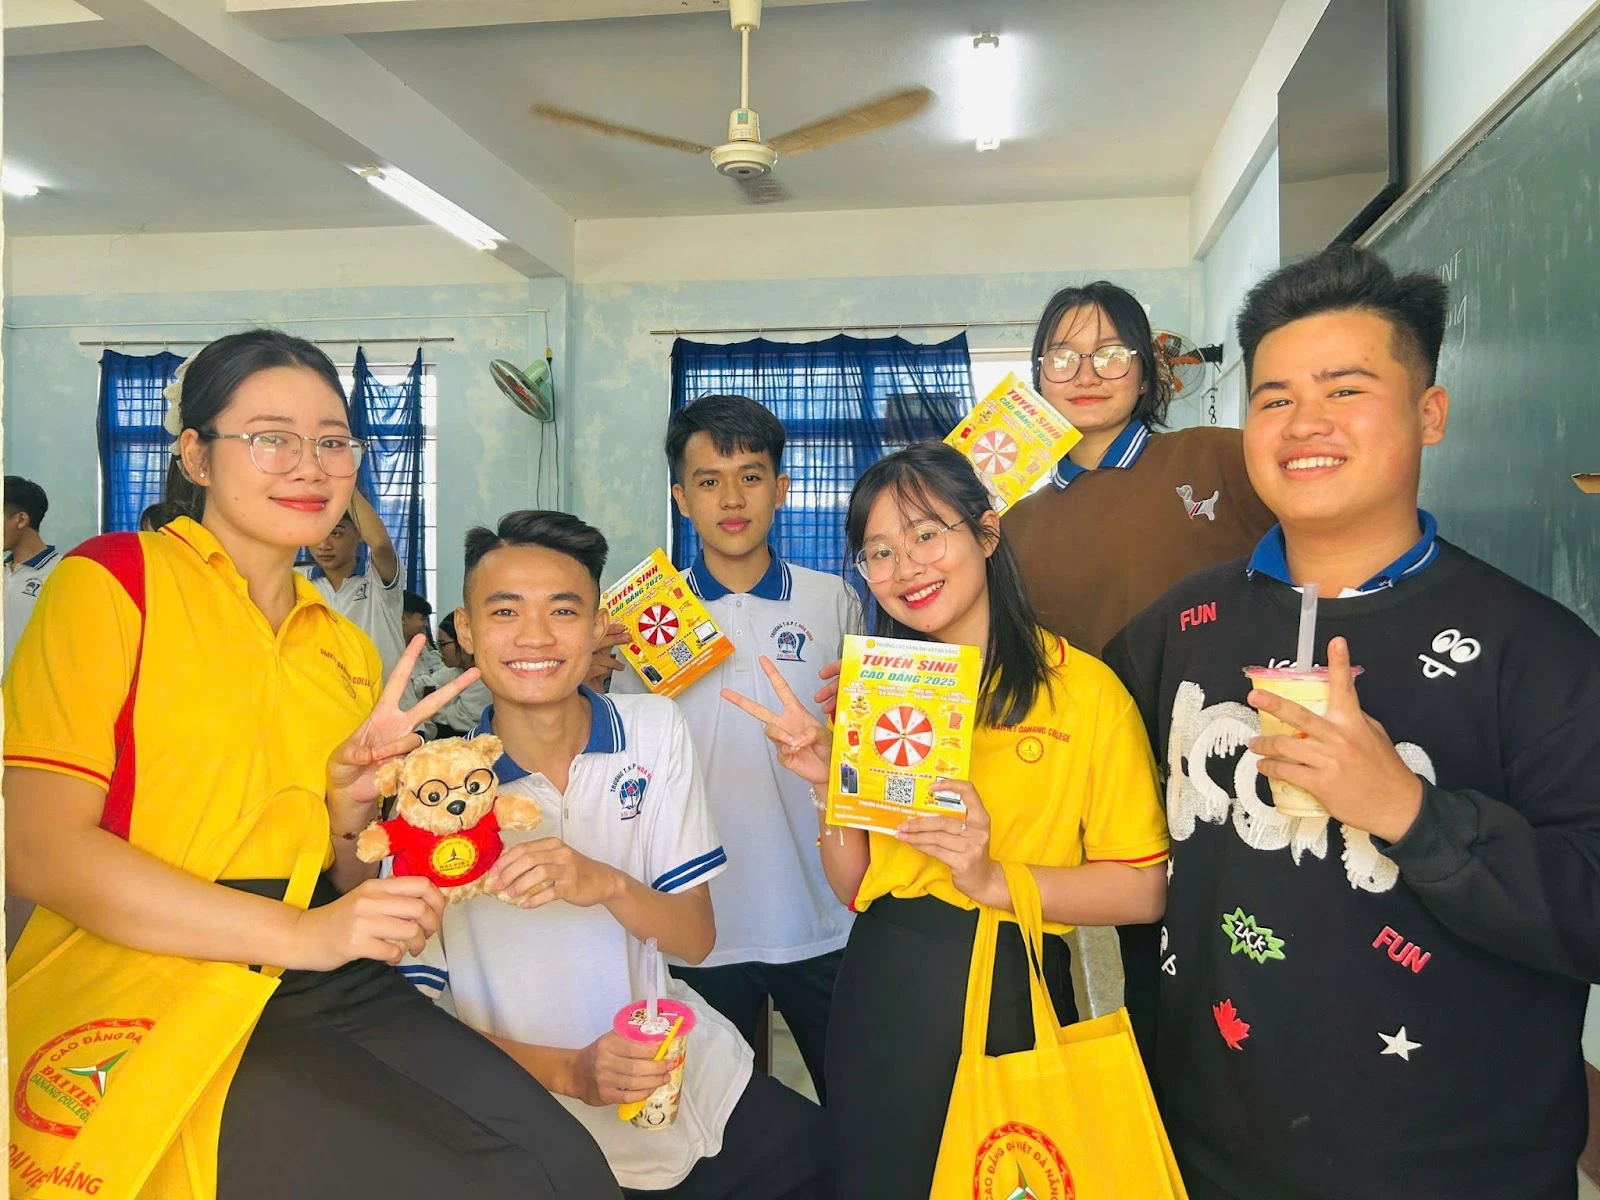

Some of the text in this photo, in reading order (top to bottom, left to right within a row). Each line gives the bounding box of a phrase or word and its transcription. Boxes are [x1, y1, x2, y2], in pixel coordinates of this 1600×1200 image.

[999, 397, 1015, 410] CAO
[1034, 429, 1053, 447] 2025
[1036, 417, 1063, 439] SINH
[635, 564, 658, 587] SINH
[610, 602, 624, 617] CAO
[645, 573, 663, 590] 2025
[1179, 601, 1217, 632] FUN
[859, 669, 885, 680] CAO
[924, 676, 957, 687] 2025
[917, 659, 959, 674] SINH
[1019, 725, 1047, 734] DANANG
[1234, 920, 1266, 952] ZACK
[1371, 925, 1432, 974] FUN
[50, 1041, 78, 1062] CAO
[30, 1073, 91, 1124] DANANG COLLEG
